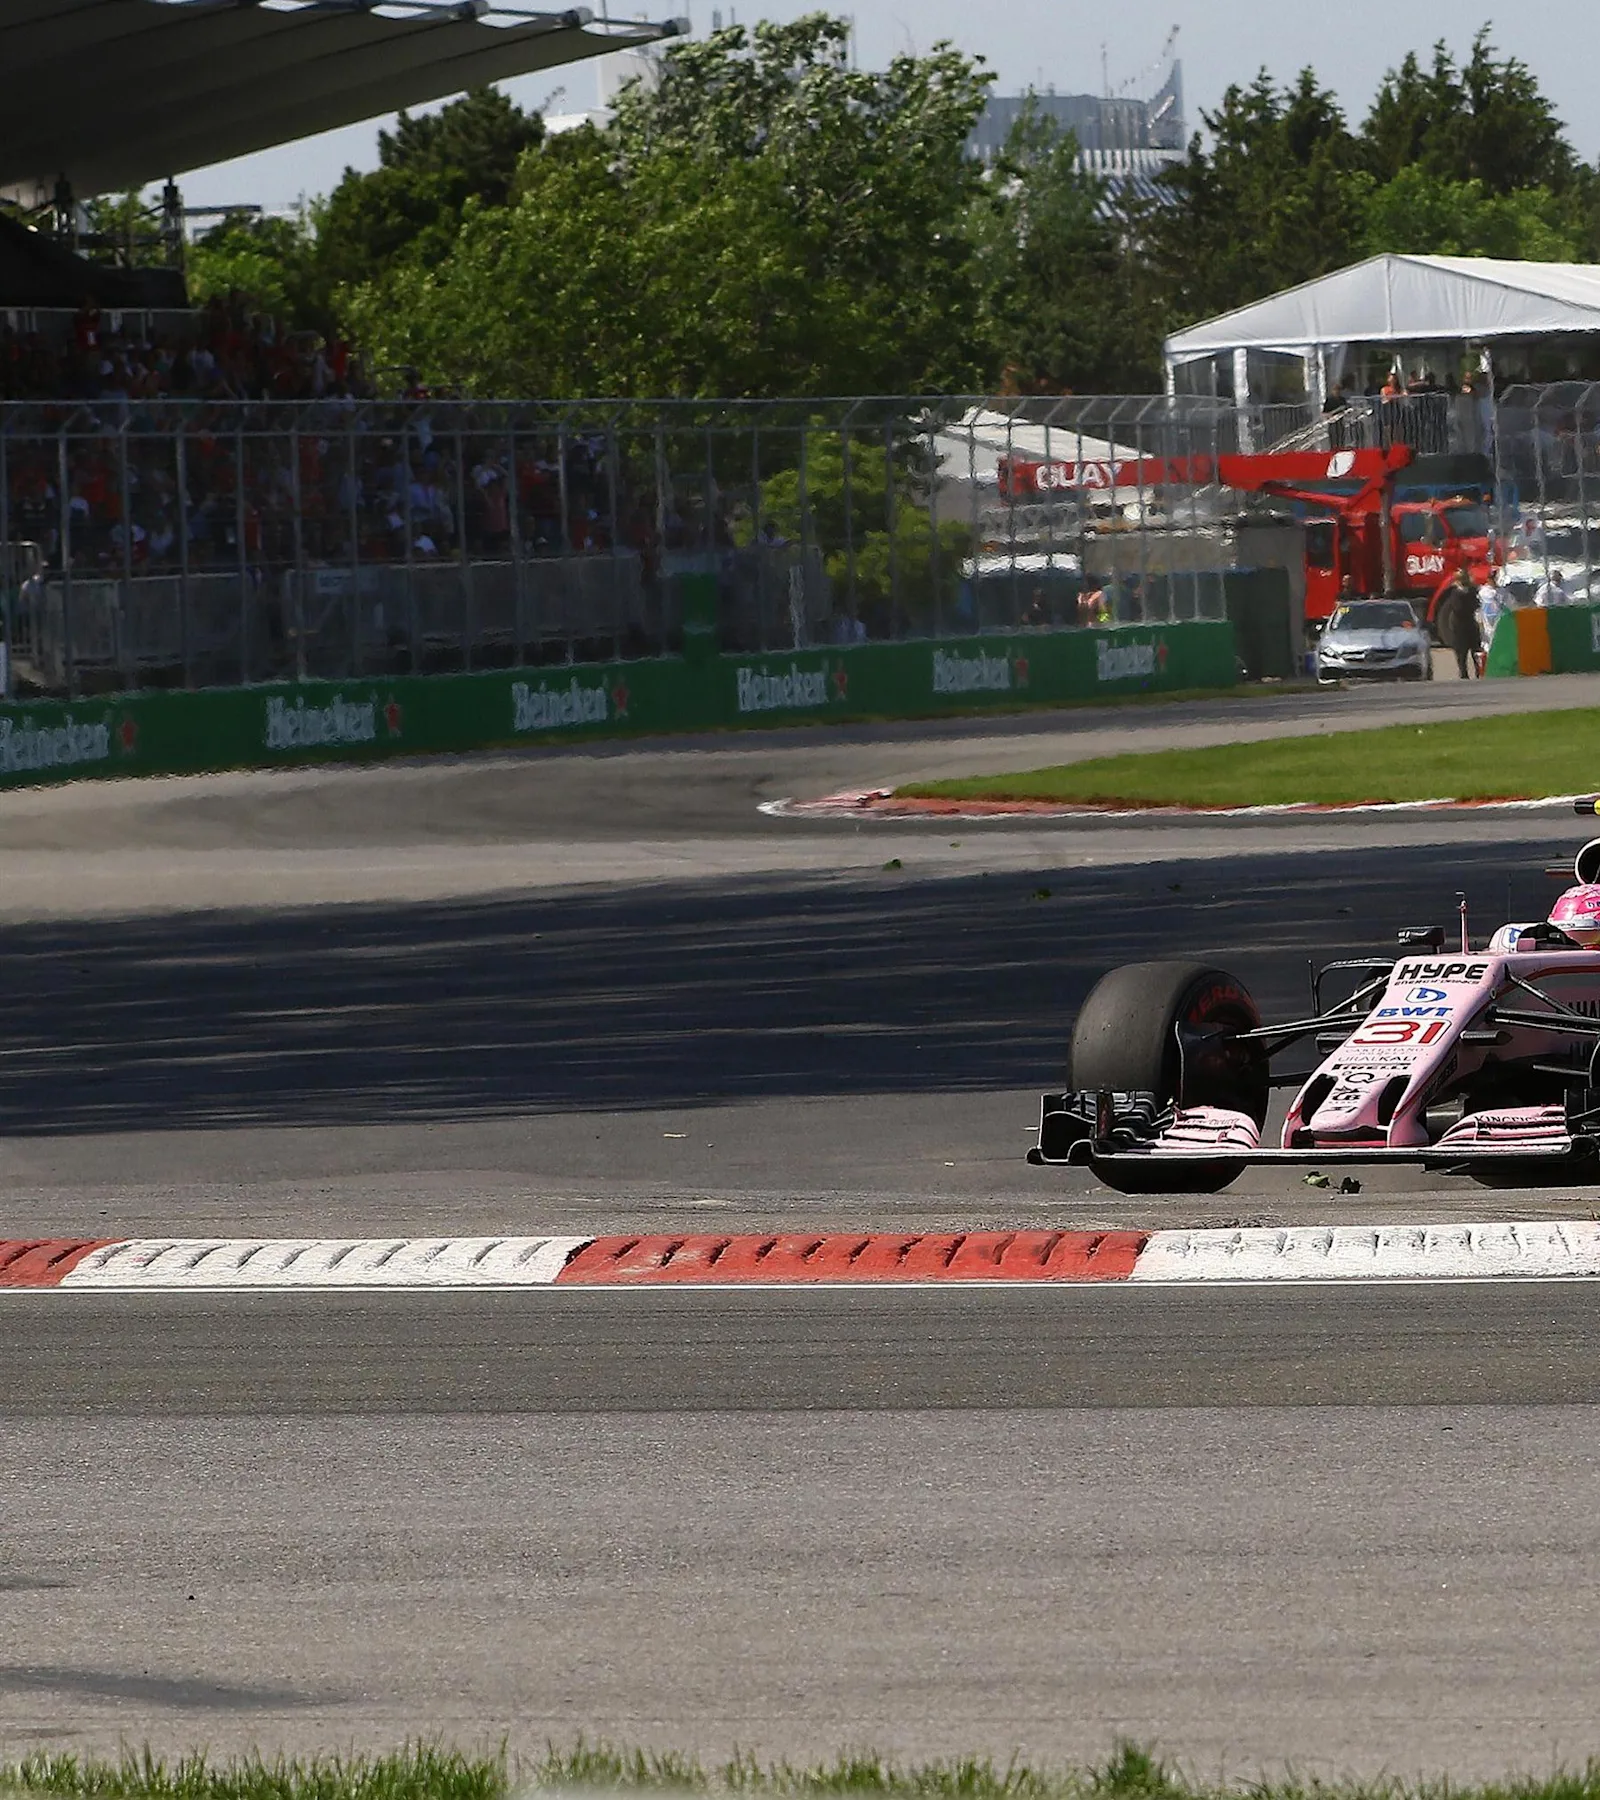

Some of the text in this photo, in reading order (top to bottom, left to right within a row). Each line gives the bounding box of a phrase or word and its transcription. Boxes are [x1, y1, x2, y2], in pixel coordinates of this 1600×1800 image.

[512, 677, 609, 732] Heineken
[737, 662, 828, 712] Heineken
[265, 695, 376, 750] Heineken
[1399, 963, 1490, 980] HYPE
[1376, 1007, 1453, 1018] BWT
[1352, 1021, 1446, 1045] 31
